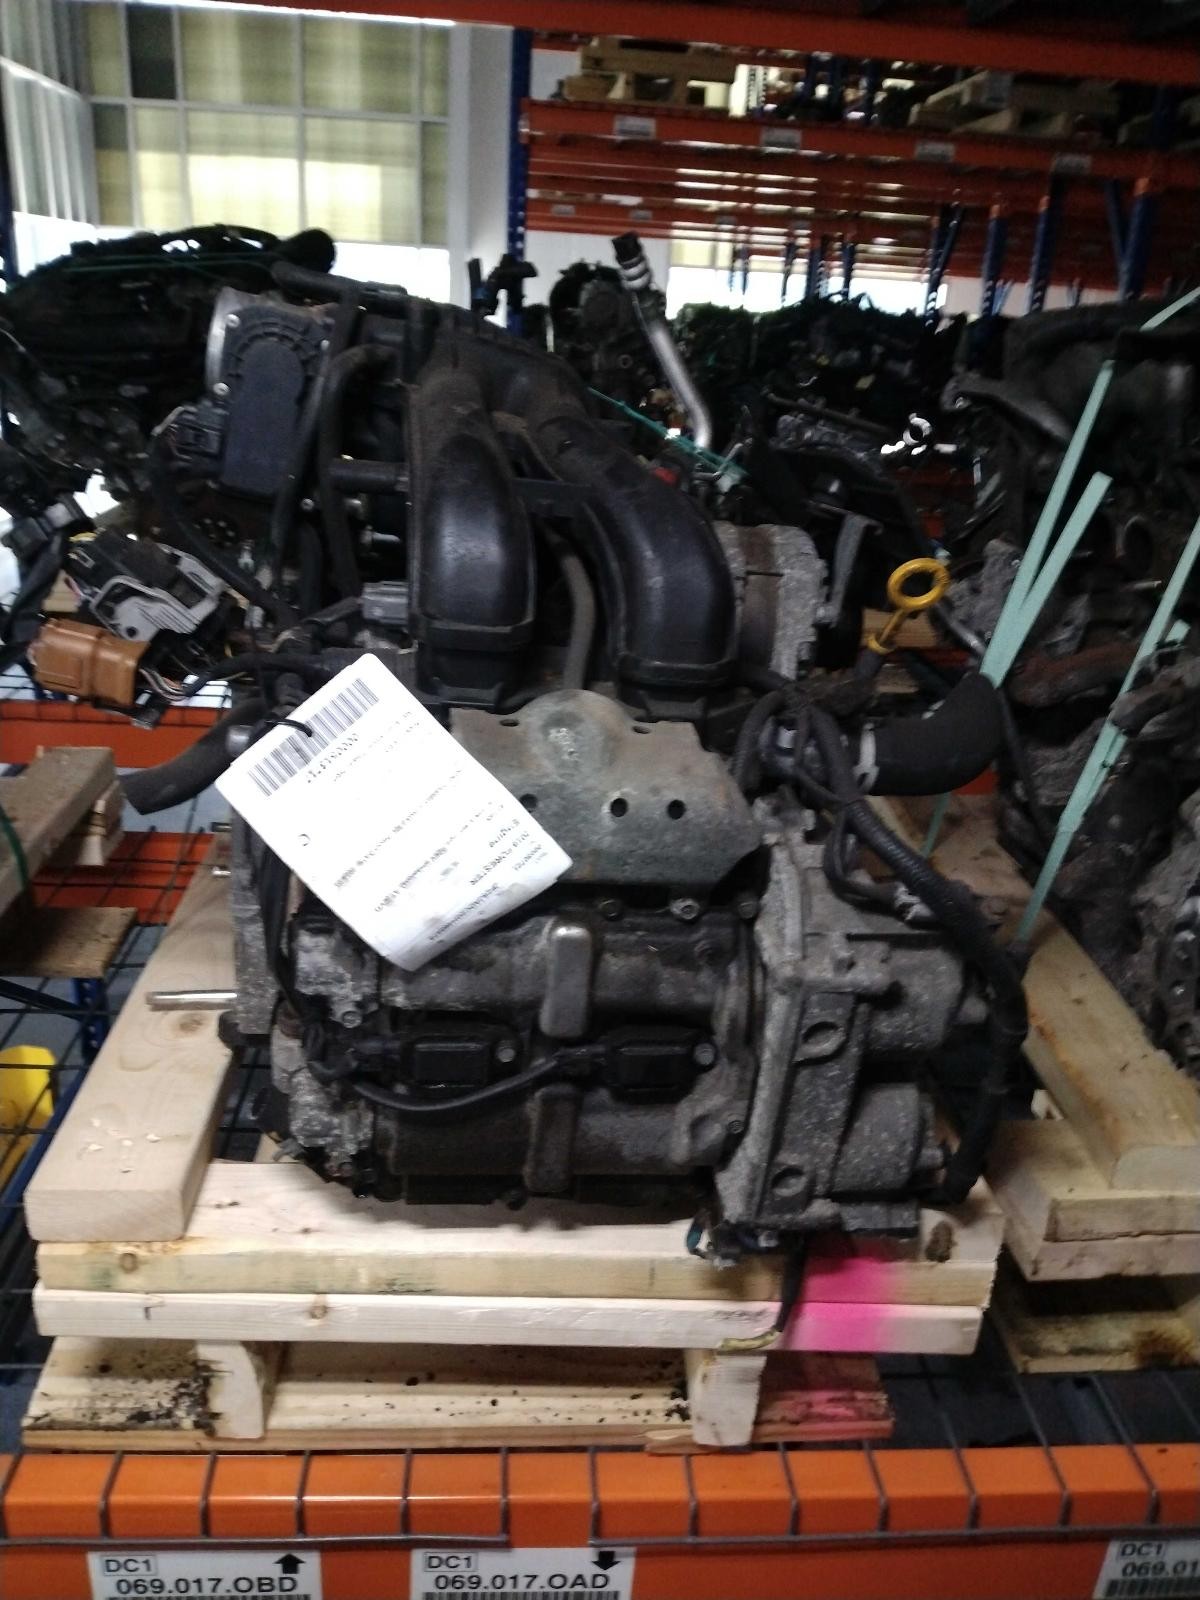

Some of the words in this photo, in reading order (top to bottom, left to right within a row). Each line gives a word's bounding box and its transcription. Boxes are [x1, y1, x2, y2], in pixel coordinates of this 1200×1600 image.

[1121, 1543, 1163, 1556] DC1
[104, 1559, 152, 1572] DC1
[428, 1556, 472, 1569] DC1
